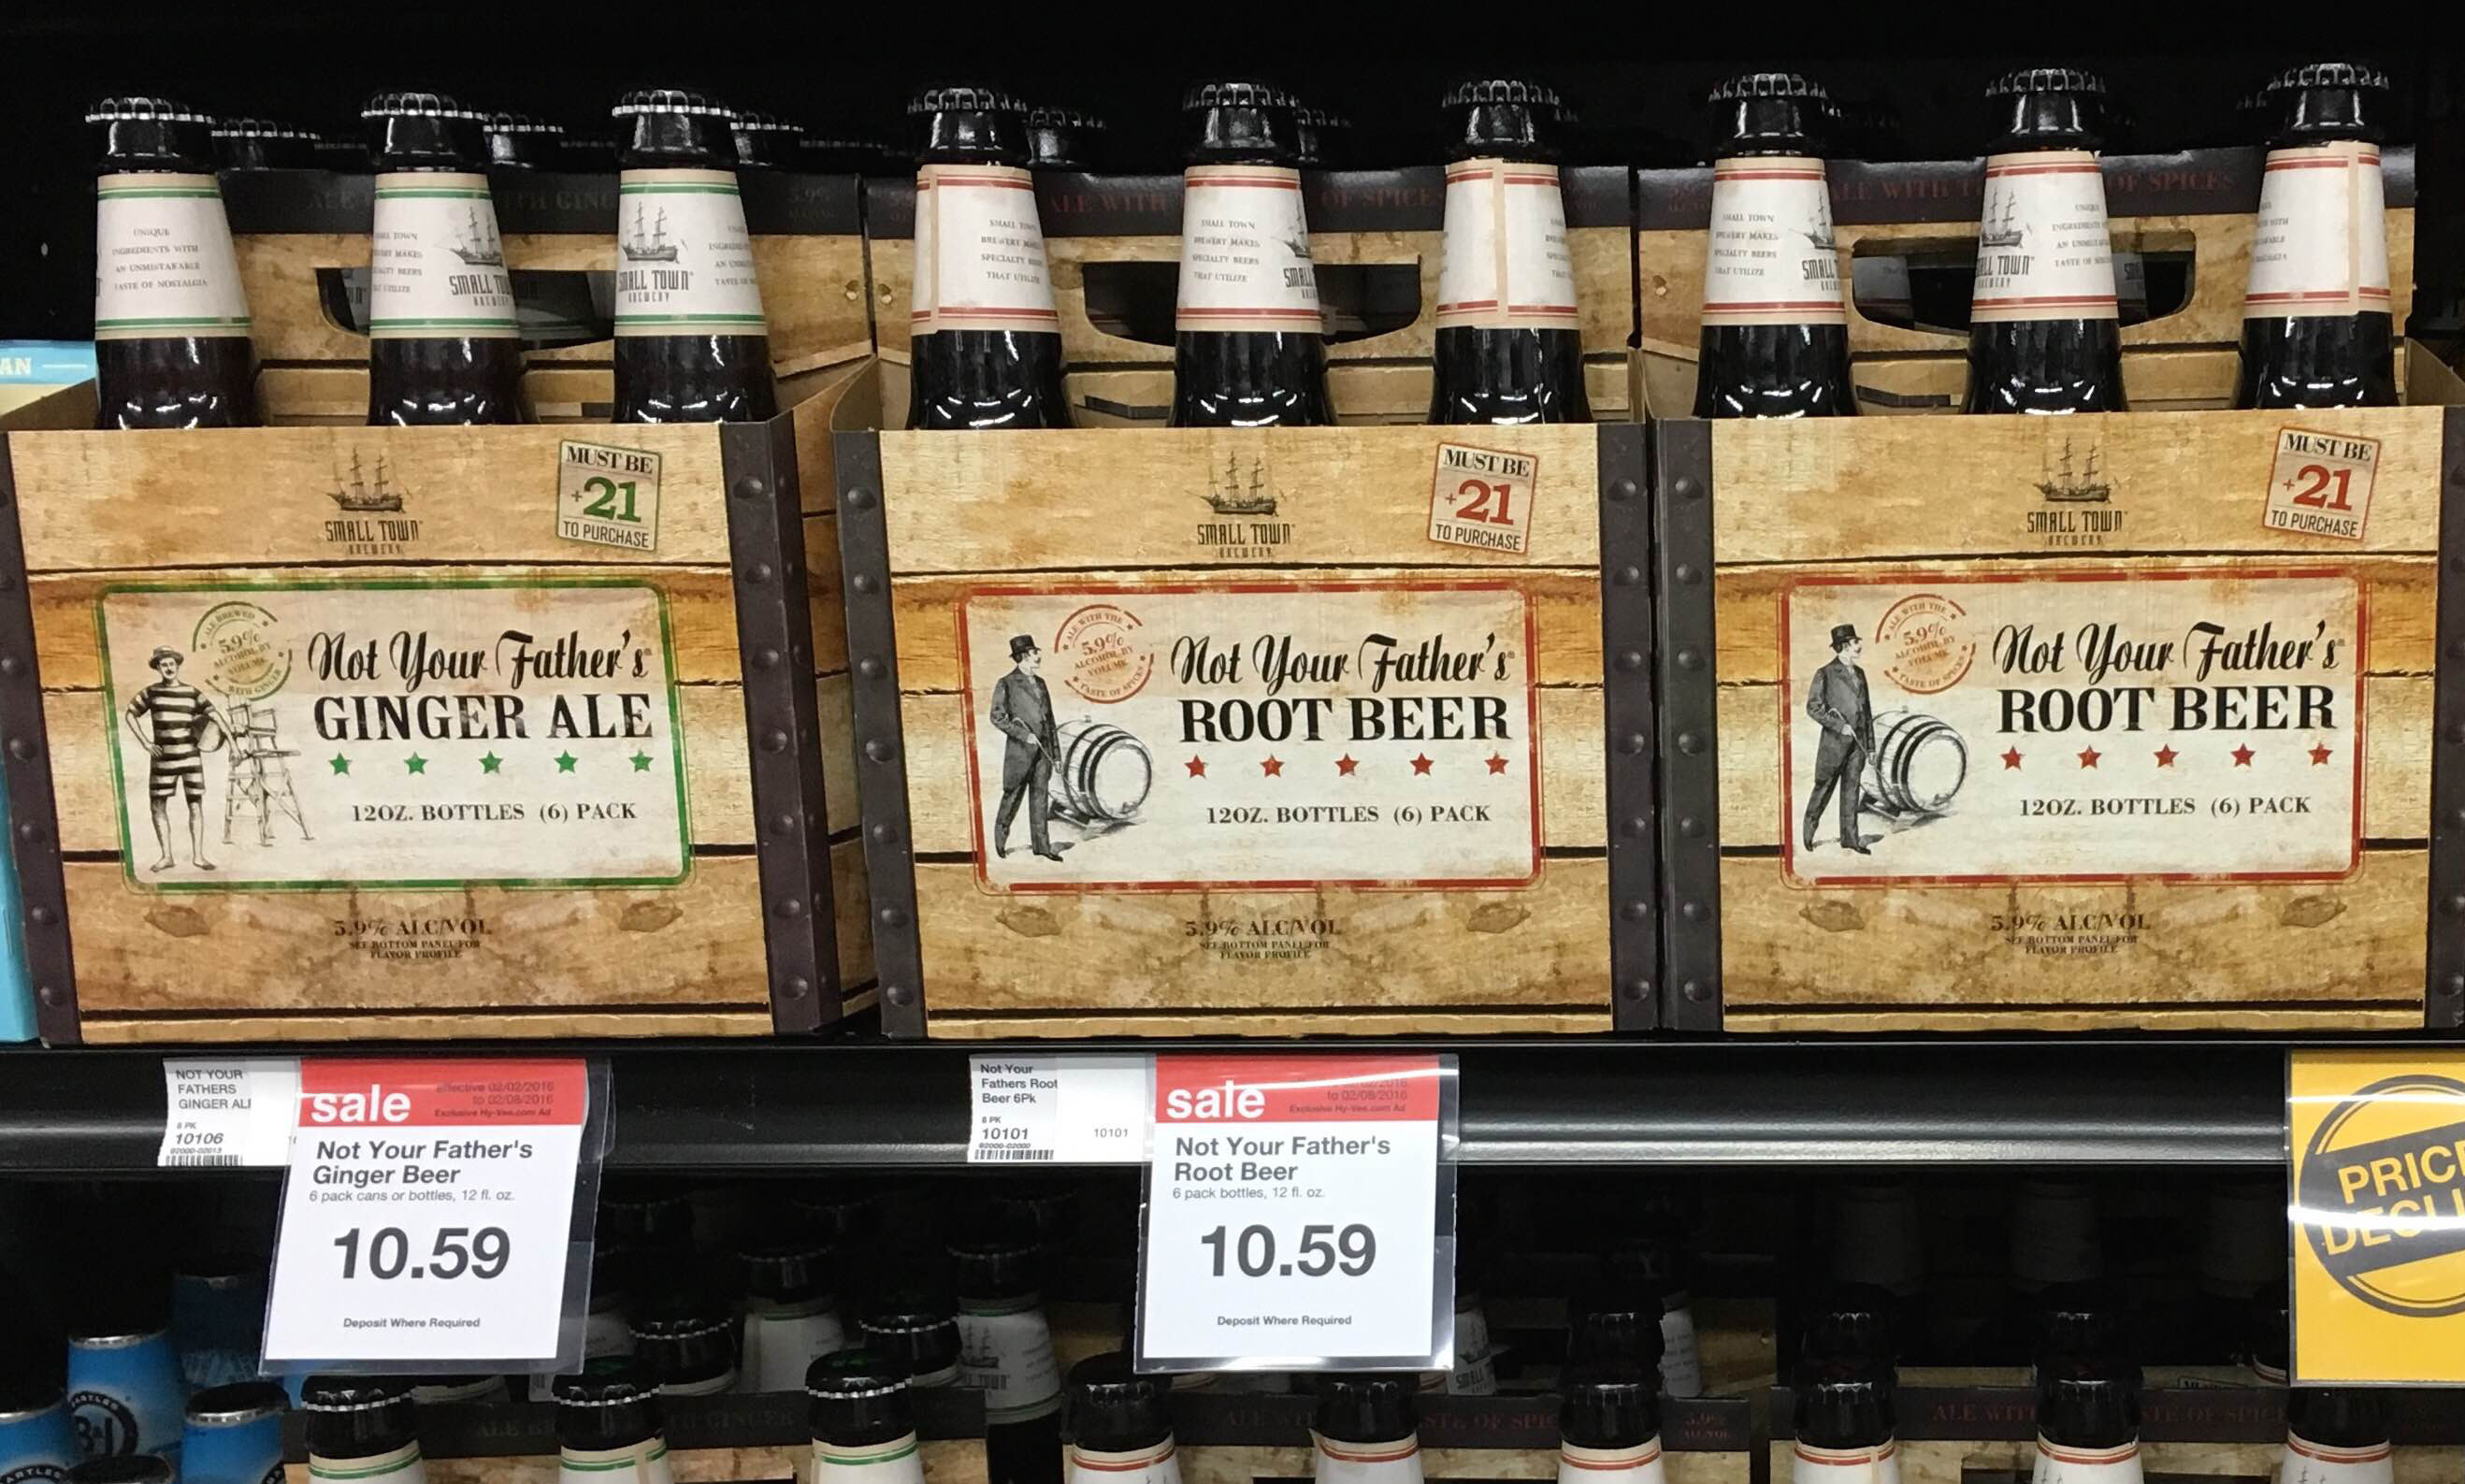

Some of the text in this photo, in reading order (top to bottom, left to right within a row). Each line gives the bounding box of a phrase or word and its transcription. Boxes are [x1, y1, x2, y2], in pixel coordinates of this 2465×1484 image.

[1997, 254, 2030, 276] TOWN
[157, 279, 209, 288] NOSTALGIA
[449, 274, 493, 295] SMALL
[652, 270, 689, 291] TOWN
[2285, 433, 2372, 461] MUST BE
[567, 446, 653, 474] MUST BE
[1443, 449, 1530, 478] MUST BE
[324, 520, 420, 541] SMALL TOWN
[2027, 510, 2123, 533] SMALL TOWN
[2271, 510, 2358, 537] TO PURCHASE
[563, 520, 649, 548] TO PURCHASE
[1197, 523, 1290, 545] SMALL TOWN
[1435, 523, 1521, 551] TO PURCHASE
[218, 629, 260, 654] 5.9%
[1081, 631, 1125, 656] 5.9%
[1903, 621, 1946, 646] 5.9%
[1120, 645, 1134, 656] BY
[1992, 624, 2066, 674] Not
[2076, 622, 2174, 685] Your
[308, 630, 382, 681] Not
[389, 630, 488, 693] Your
[1171, 634, 1244, 685] Not
[1252, 633, 1350, 697] Your
[314, 693, 654, 741] GINGER ALE
[1177, 696, 1513, 742] ROOT BEER
[1997, 684, 2338, 733] ROOT BEER
[352, 802, 637, 824] 12OZ. BOTTLES (6) PACK
[1206, 805, 1492, 826] 12OZ. BOTTLES (6) PACK
[2020, 797, 2312, 818] 12OZ. BOTTLES (6) PACK
[334, 918, 391, 936] 5.9%
[1185, 919, 1241, 937] 5.9%
[1990, 913, 2048, 932] 5.9%
[2025, 944, 2117, 955] FLAVOR PROFILE
[2027, 935, 2074, 944] BOTTOM
[2078, 935, 2112, 944] PANEL
[2115, 935, 2138, 944] FOR
[176, 1069, 243, 1079] NOT YOUR
[981, 1064, 1033, 1073] Not Your
[178, 1084, 237, 1094] FATHERS
[982, 1078, 1058, 1088] Fathers Root
[179, 1099, 228, 1109] GINGER
[310, 1084, 411, 1123] sale
[473, 1095, 485, 1104] to
[983, 1092, 1036, 1103] Beer 6Pk
[1167, 1080, 1265, 1118] sale
[1327, 1091, 1338, 1101] to
[538, 1107, 551, 1117] Ad
[176, 1132, 224, 1145] 10106
[983, 1128, 1129, 1140] 10101 10101
[317, 1140, 533, 1160] Not Your Father's
[1175, 1135, 1391, 1156] Not Your Father's
[312, 1165, 460, 1188] Ginger Beer
[1175, 1162, 1298, 1181] Root Beer
[310, 1189, 515, 1204] 6 pack cans or bottles, 12 fl. oz.
[1173, 1187, 1325, 1201] 6 pack bottles, 12 fl. oz.
[334, 1227, 511, 1279] 10.59
[1202, 1223, 1377, 1277] 10.59
[343, 1318, 481, 1330] Deposit Where Required
[1218, 1315, 1352, 1327] Deposit Where Required
